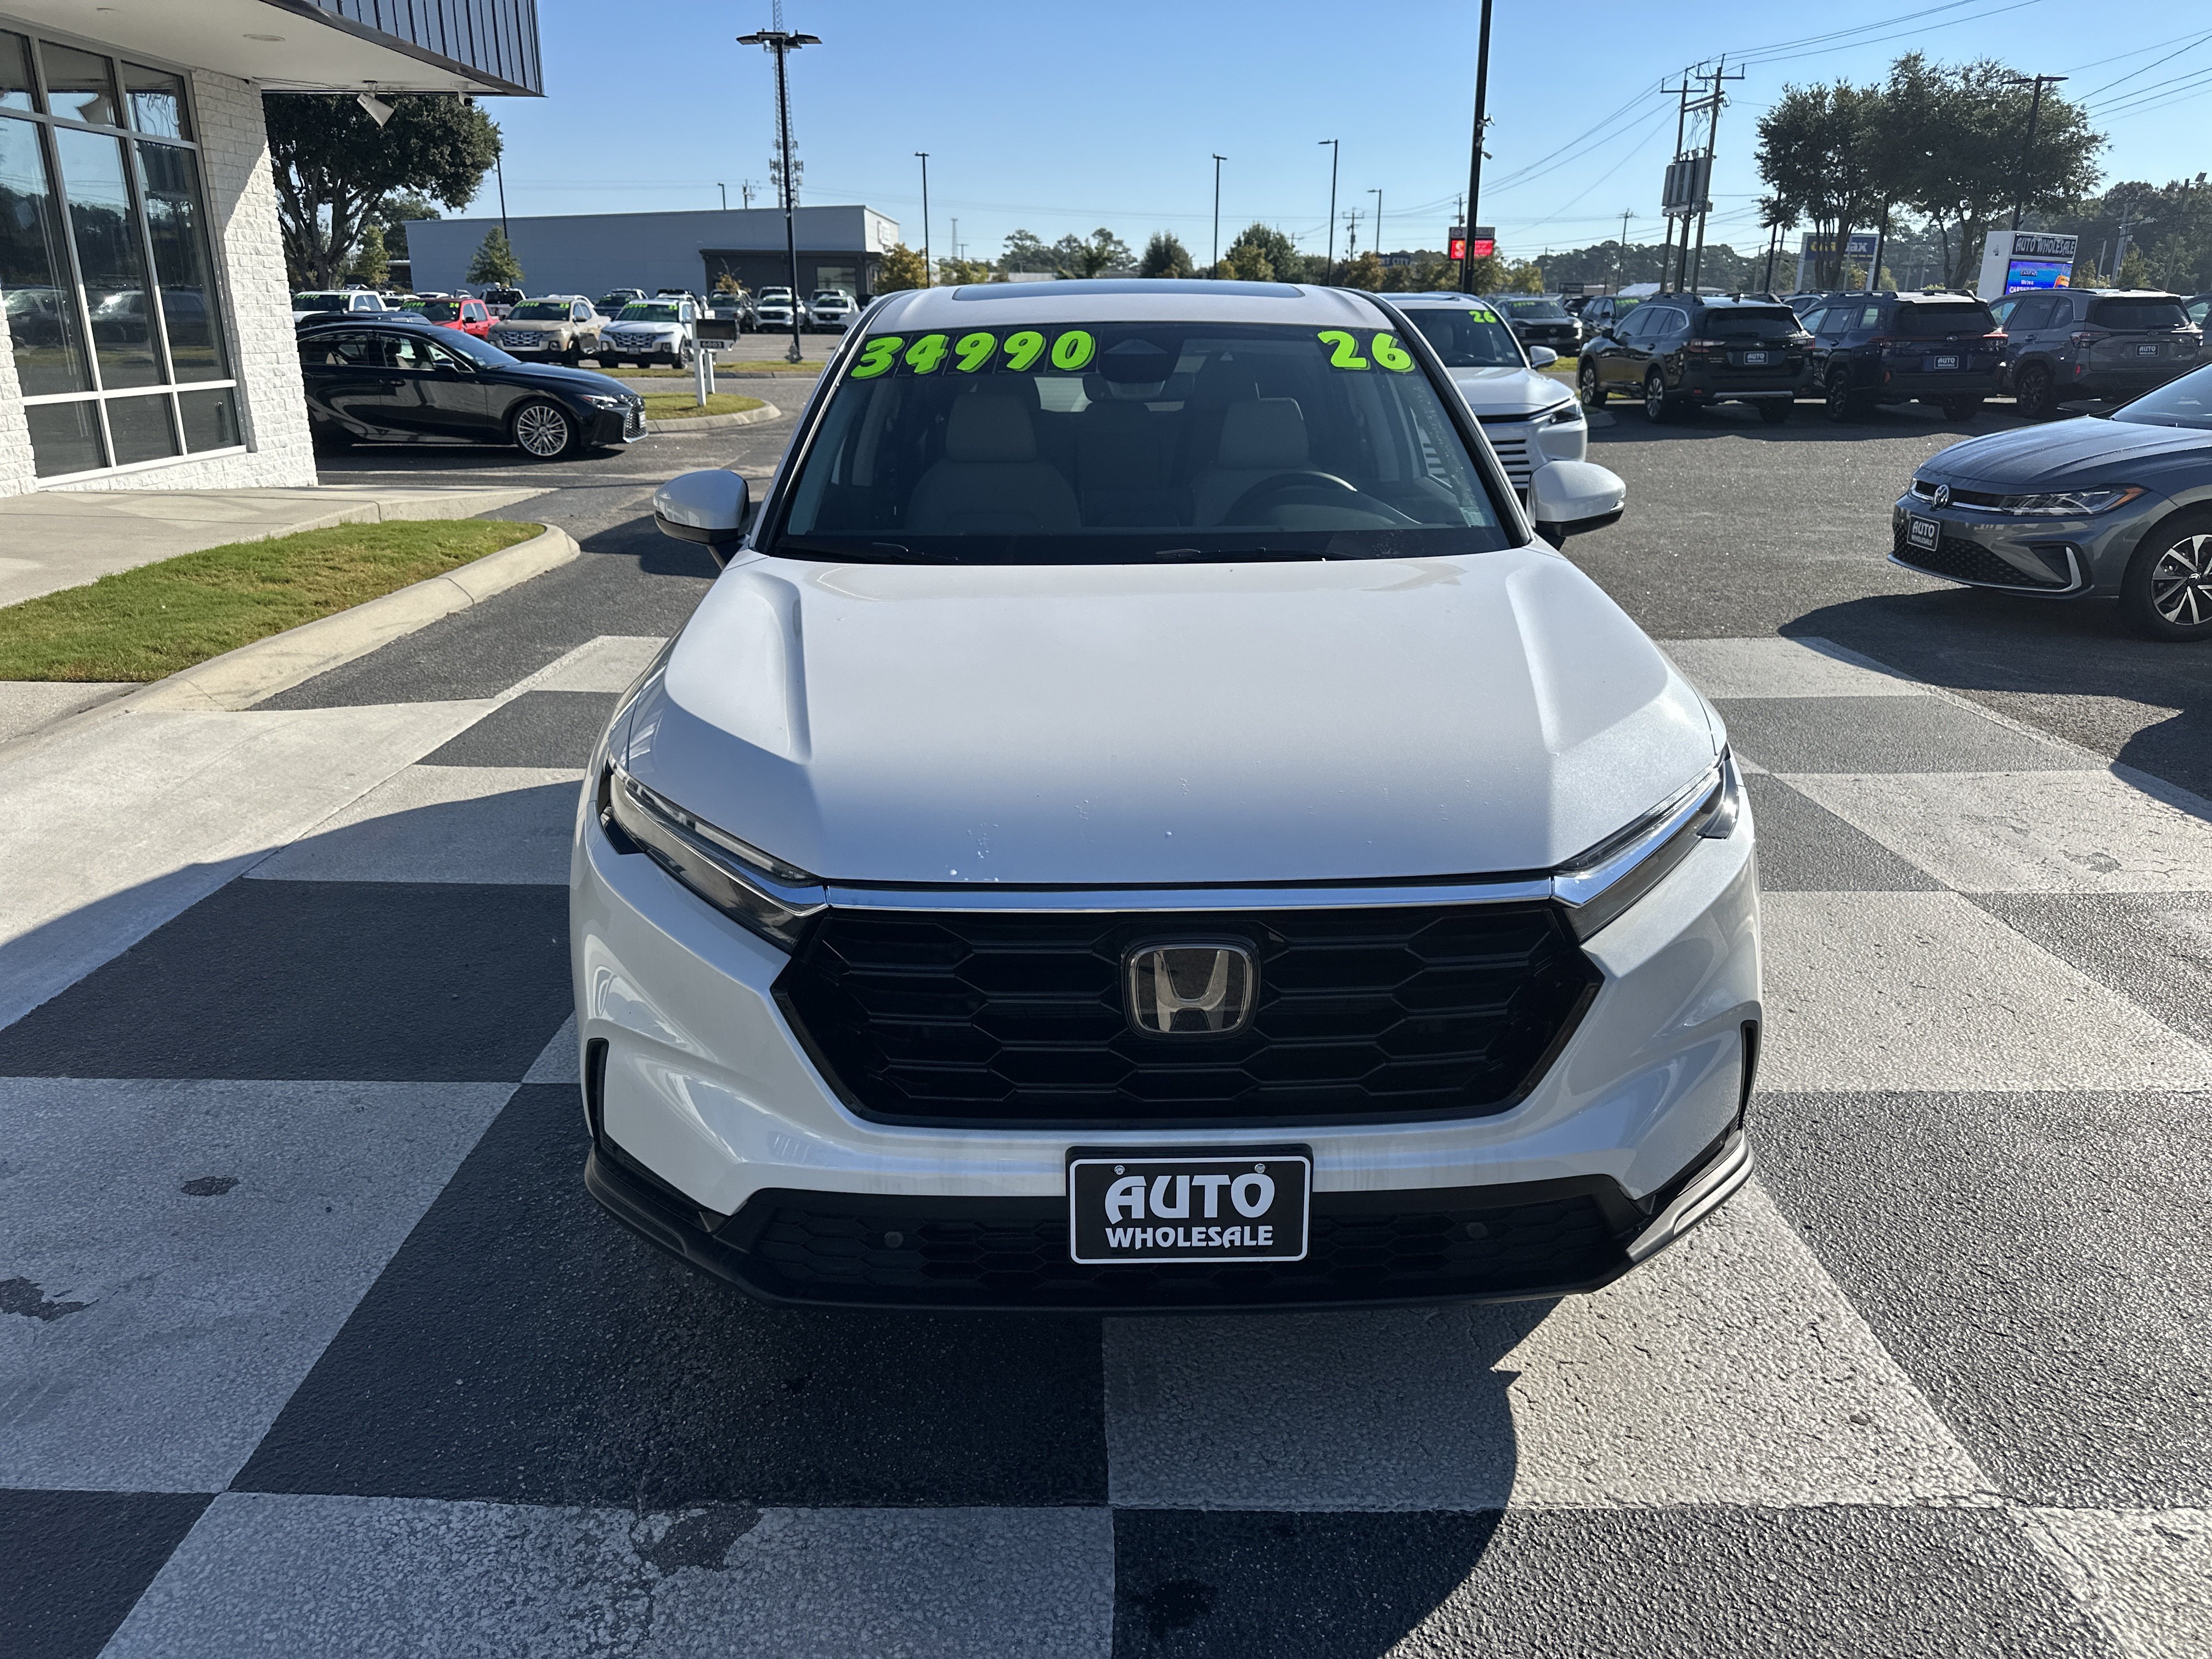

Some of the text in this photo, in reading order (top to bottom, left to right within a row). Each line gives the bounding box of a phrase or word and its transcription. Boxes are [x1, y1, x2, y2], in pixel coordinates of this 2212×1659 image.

[2016, 237, 2075, 256] AUTO WHOLESALE
[1469, 311, 1497, 324] 26
[850, 330, 1096, 380] 34990
[1317, 330, 1415, 374] 26
[1912, 521, 1935, 538] AUTO
[1104, 1172, 1275, 1224] AUTO
[1105, 1225, 1273, 1250] WHOLESALE
